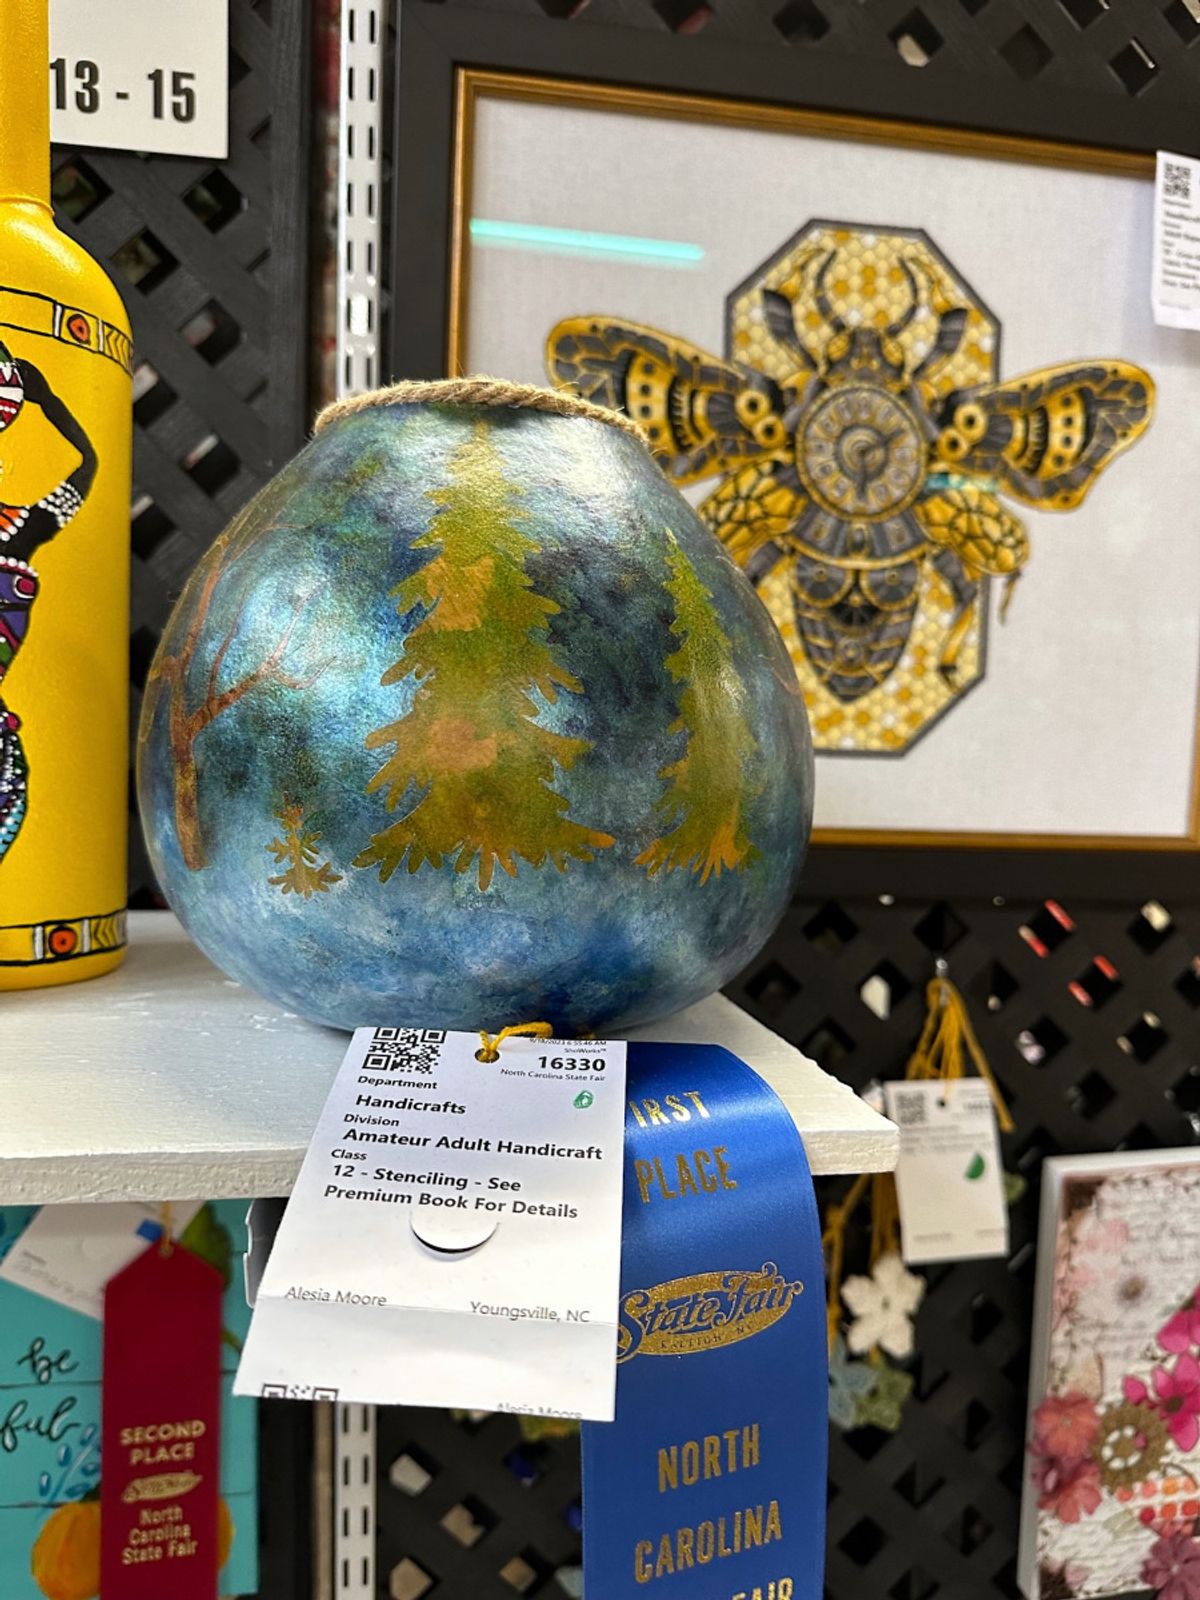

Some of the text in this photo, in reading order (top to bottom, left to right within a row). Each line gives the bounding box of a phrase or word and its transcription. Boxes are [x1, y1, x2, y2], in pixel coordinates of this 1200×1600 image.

[50, 58, 99, 113] 13
[147, 69, 195, 122] 15
[500, 1068, 526, 1077] North
[527, 1071, 563, 1079] Carolina
[538, 1056, 606, 1071] 16330
[357, 1076, 438, 1089] Department
[355, 1094, 467, 1115] Handicrafts
[629, 1091, 710, 1128] IRST
[343, 1113, 400, 1127] Division
[330, 1149, 367, 1160] Class
[342, 1128, 603, 1160] Amateur Adult Handicraft
[333, 1164, 355, 1178] 12
[373, 1168, 468, 1191] Stenciling
[487, 1177, 521, 1192] See
[633, 1145, 738, 1203] PLACE
[324, 1184, 579, 1219] Premium Book For Details
[284, 1286, 388, 1307] Alesia Moore
[470, 1301, 591, 1323] Youngsville, NC
[617, 1262, 803, 1363] State Fair
[17, 1336, 80, 1385] be
[119, 1419, 206, 1446] SECOND
[130, 1441, 195, 1465] PLACE
[657, 1423, 760, 1493] NORTH
[139, 1504, 183, 1525] North
[129, 1523, 192, 1545] Carolina
[634, 1500, 783, 1583] CAROLINA
[121, 1537, 198, 1565] State Fair
